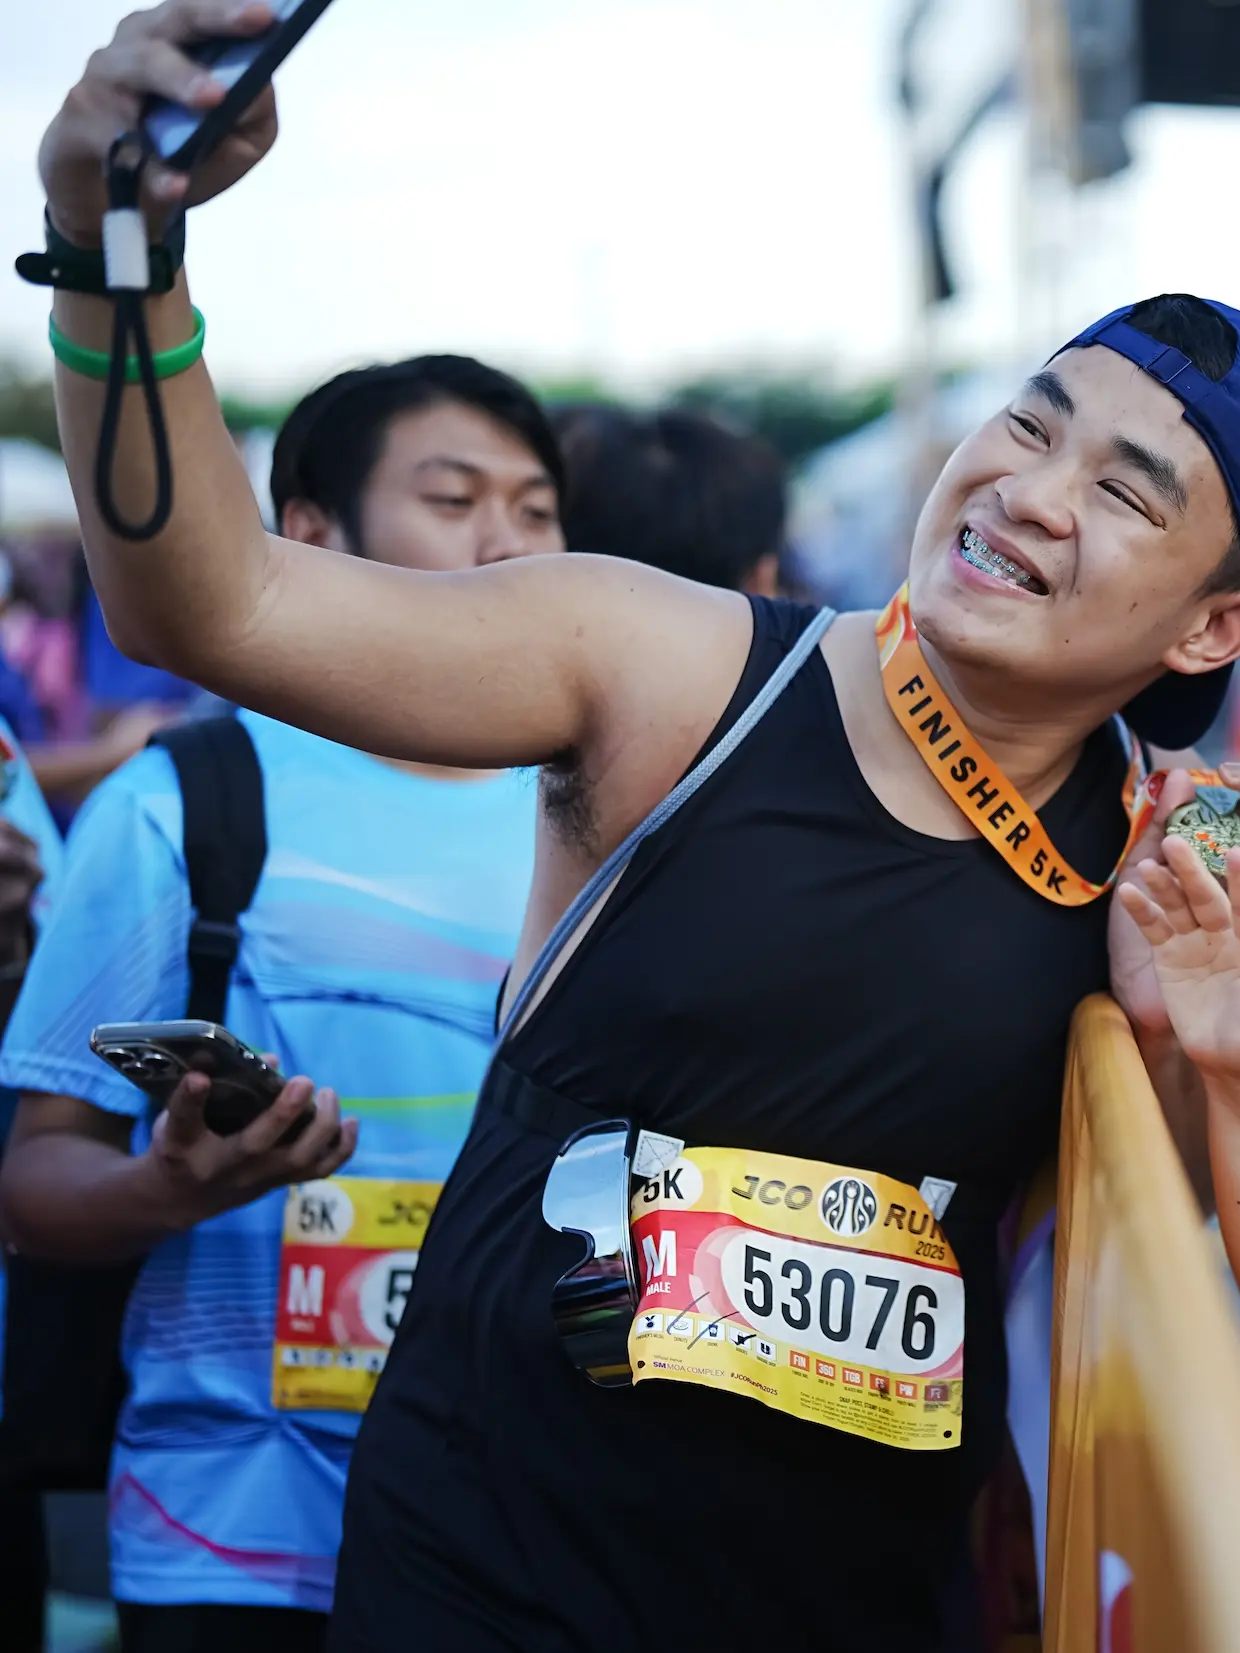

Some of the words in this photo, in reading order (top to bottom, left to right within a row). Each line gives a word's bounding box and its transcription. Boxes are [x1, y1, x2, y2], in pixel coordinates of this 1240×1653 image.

[898, 675, 1031, 851] FINISHER
[1030, 848, 1069, 896] 5K
[642, 1168, 685, 1203] 5K
[731, 1175, 813, 1210] JCO
[298, 1196, 339, 1236] 5K
[376, 1199, 434, 1226] JC
[641, 1229, 677, 1286] M
[915, 1240, 946, 1261] 2025
[287, 1264, 324, 1317] M
[646, 1281, 672, 1297] MALE
[744, 1245, 939, 1361] 53076
[653, 1361, 666, 1369] SM
[666, 1363, 686, 1373] MOA
[687, 1366, 726, 1377] COMPLEX
[793, 1354, 807, 1368] FIN
